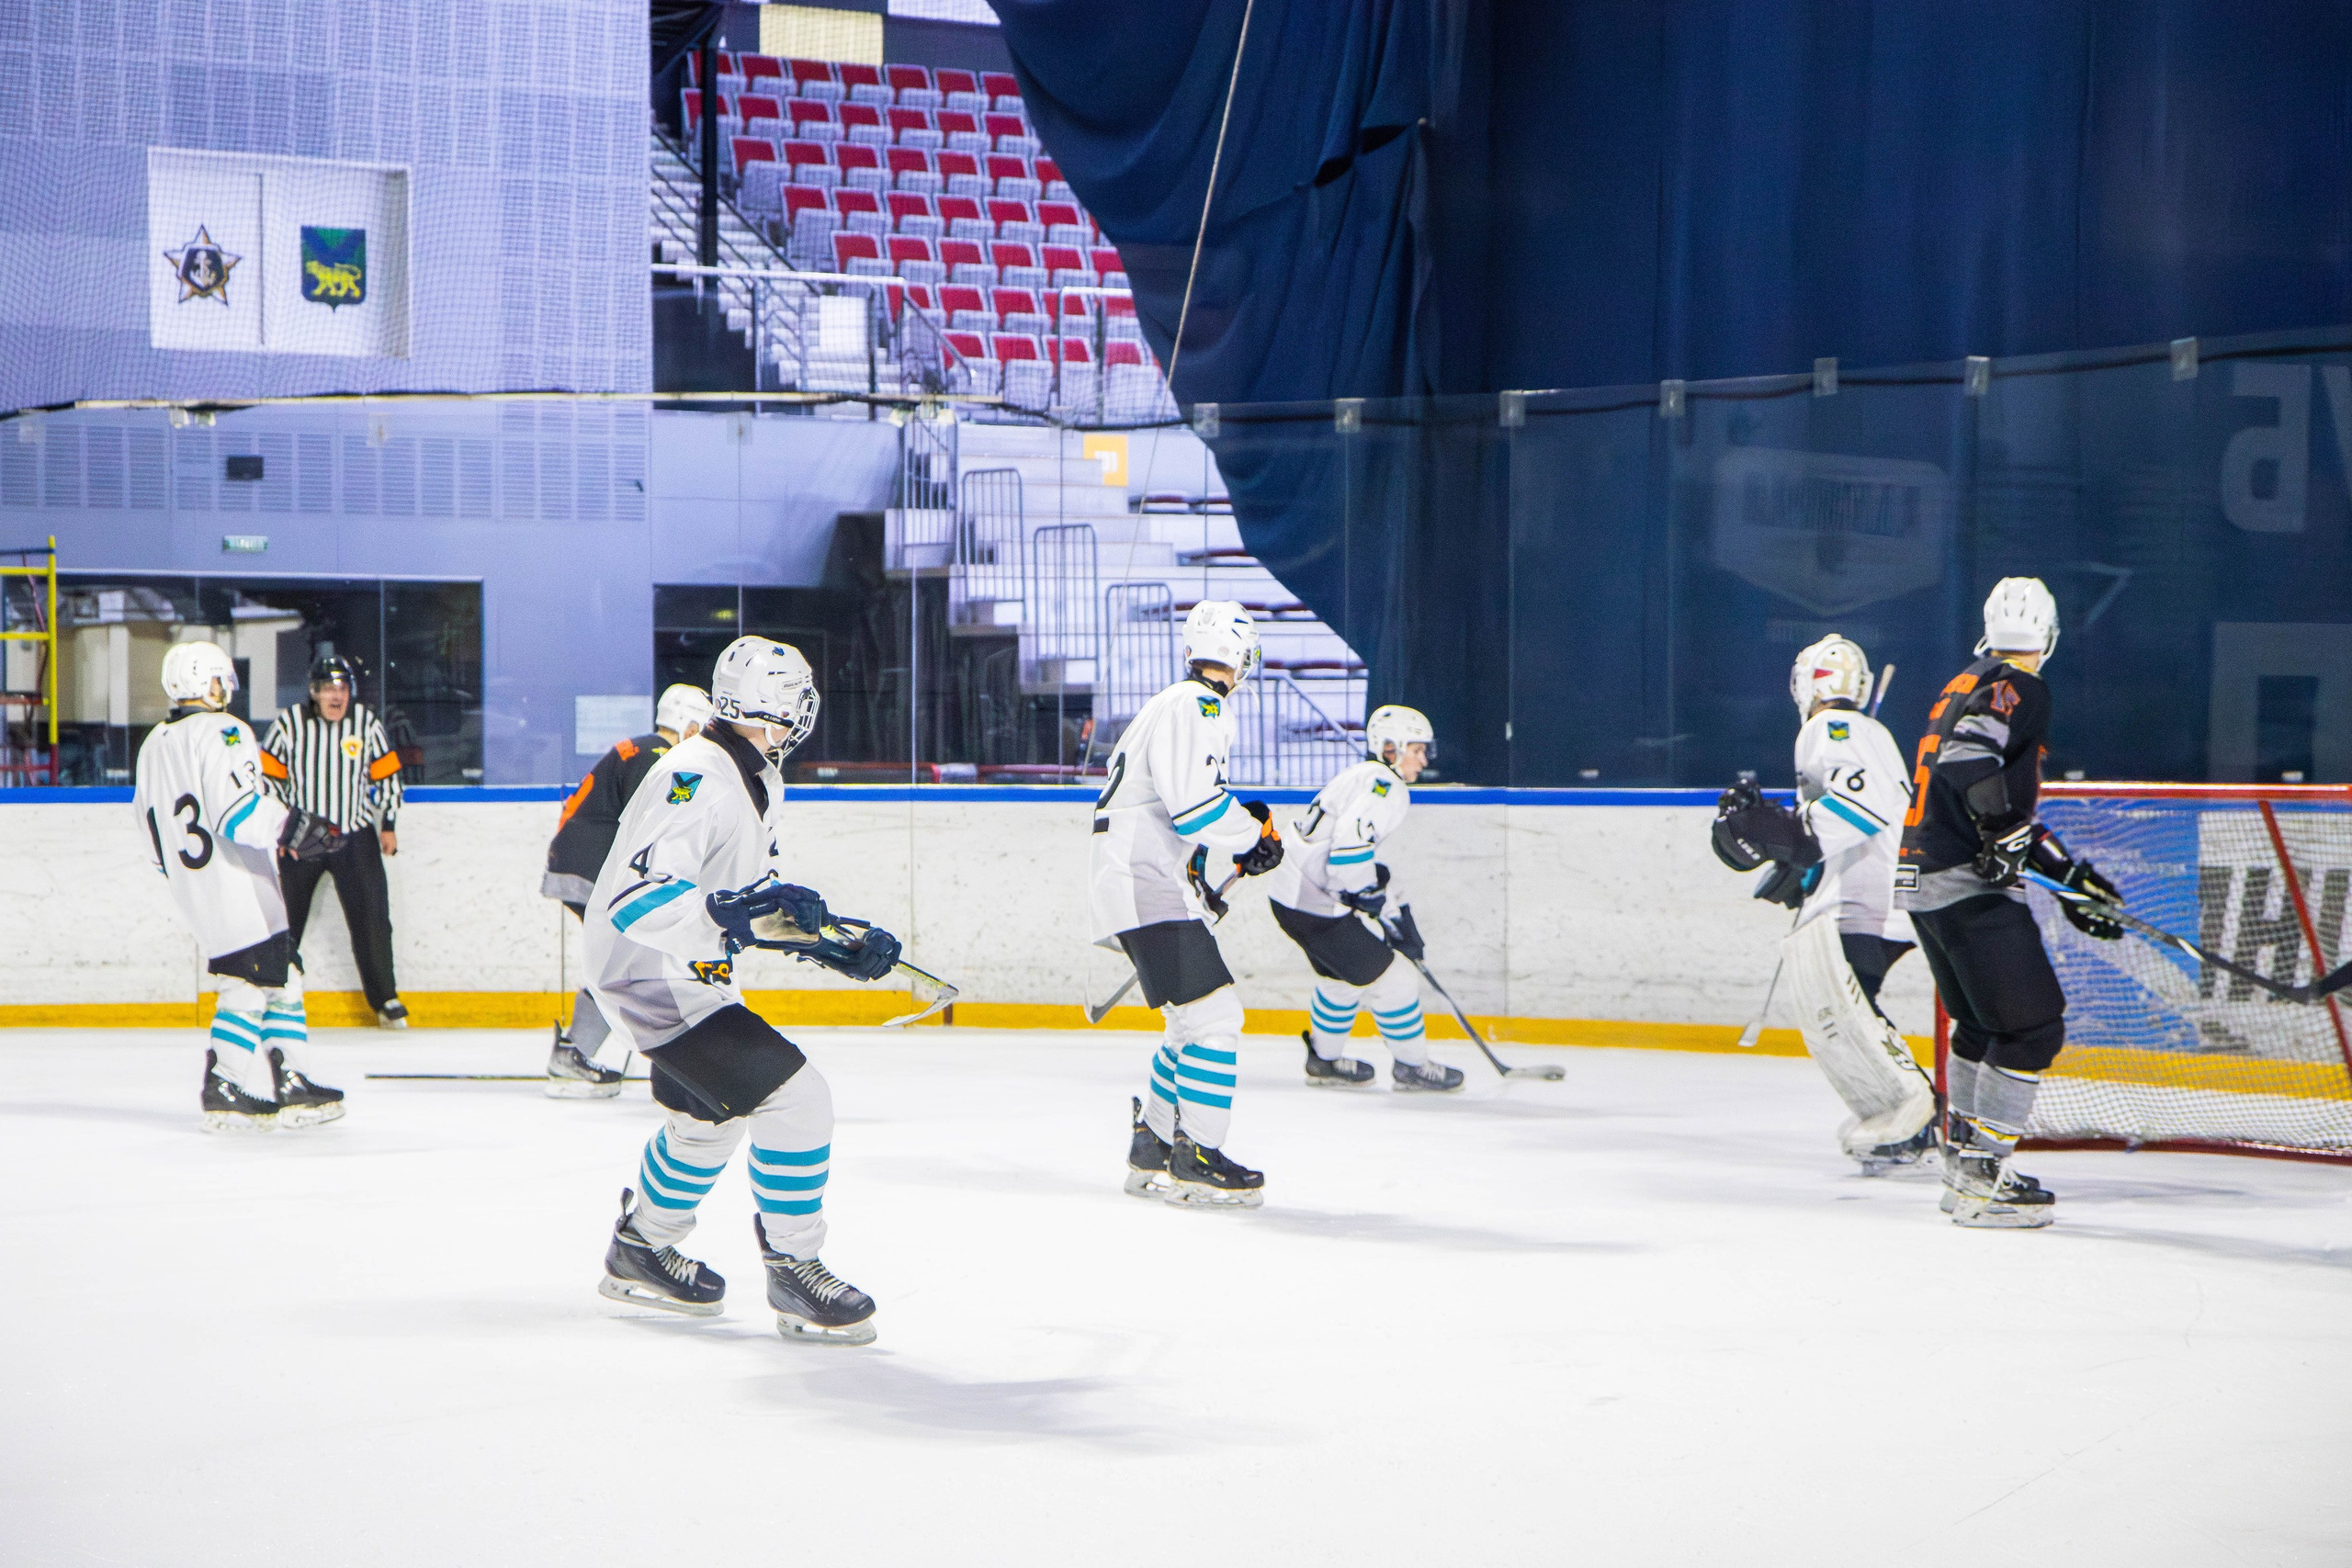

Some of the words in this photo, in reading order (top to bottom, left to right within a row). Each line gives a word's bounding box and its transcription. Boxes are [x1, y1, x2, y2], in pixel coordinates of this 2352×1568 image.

[719, 695, 741, 720] 25
[230, 761, 256, 790] 13
[1830, 768, 1866, 793] 16
[146, 792, 214, 879] 13
